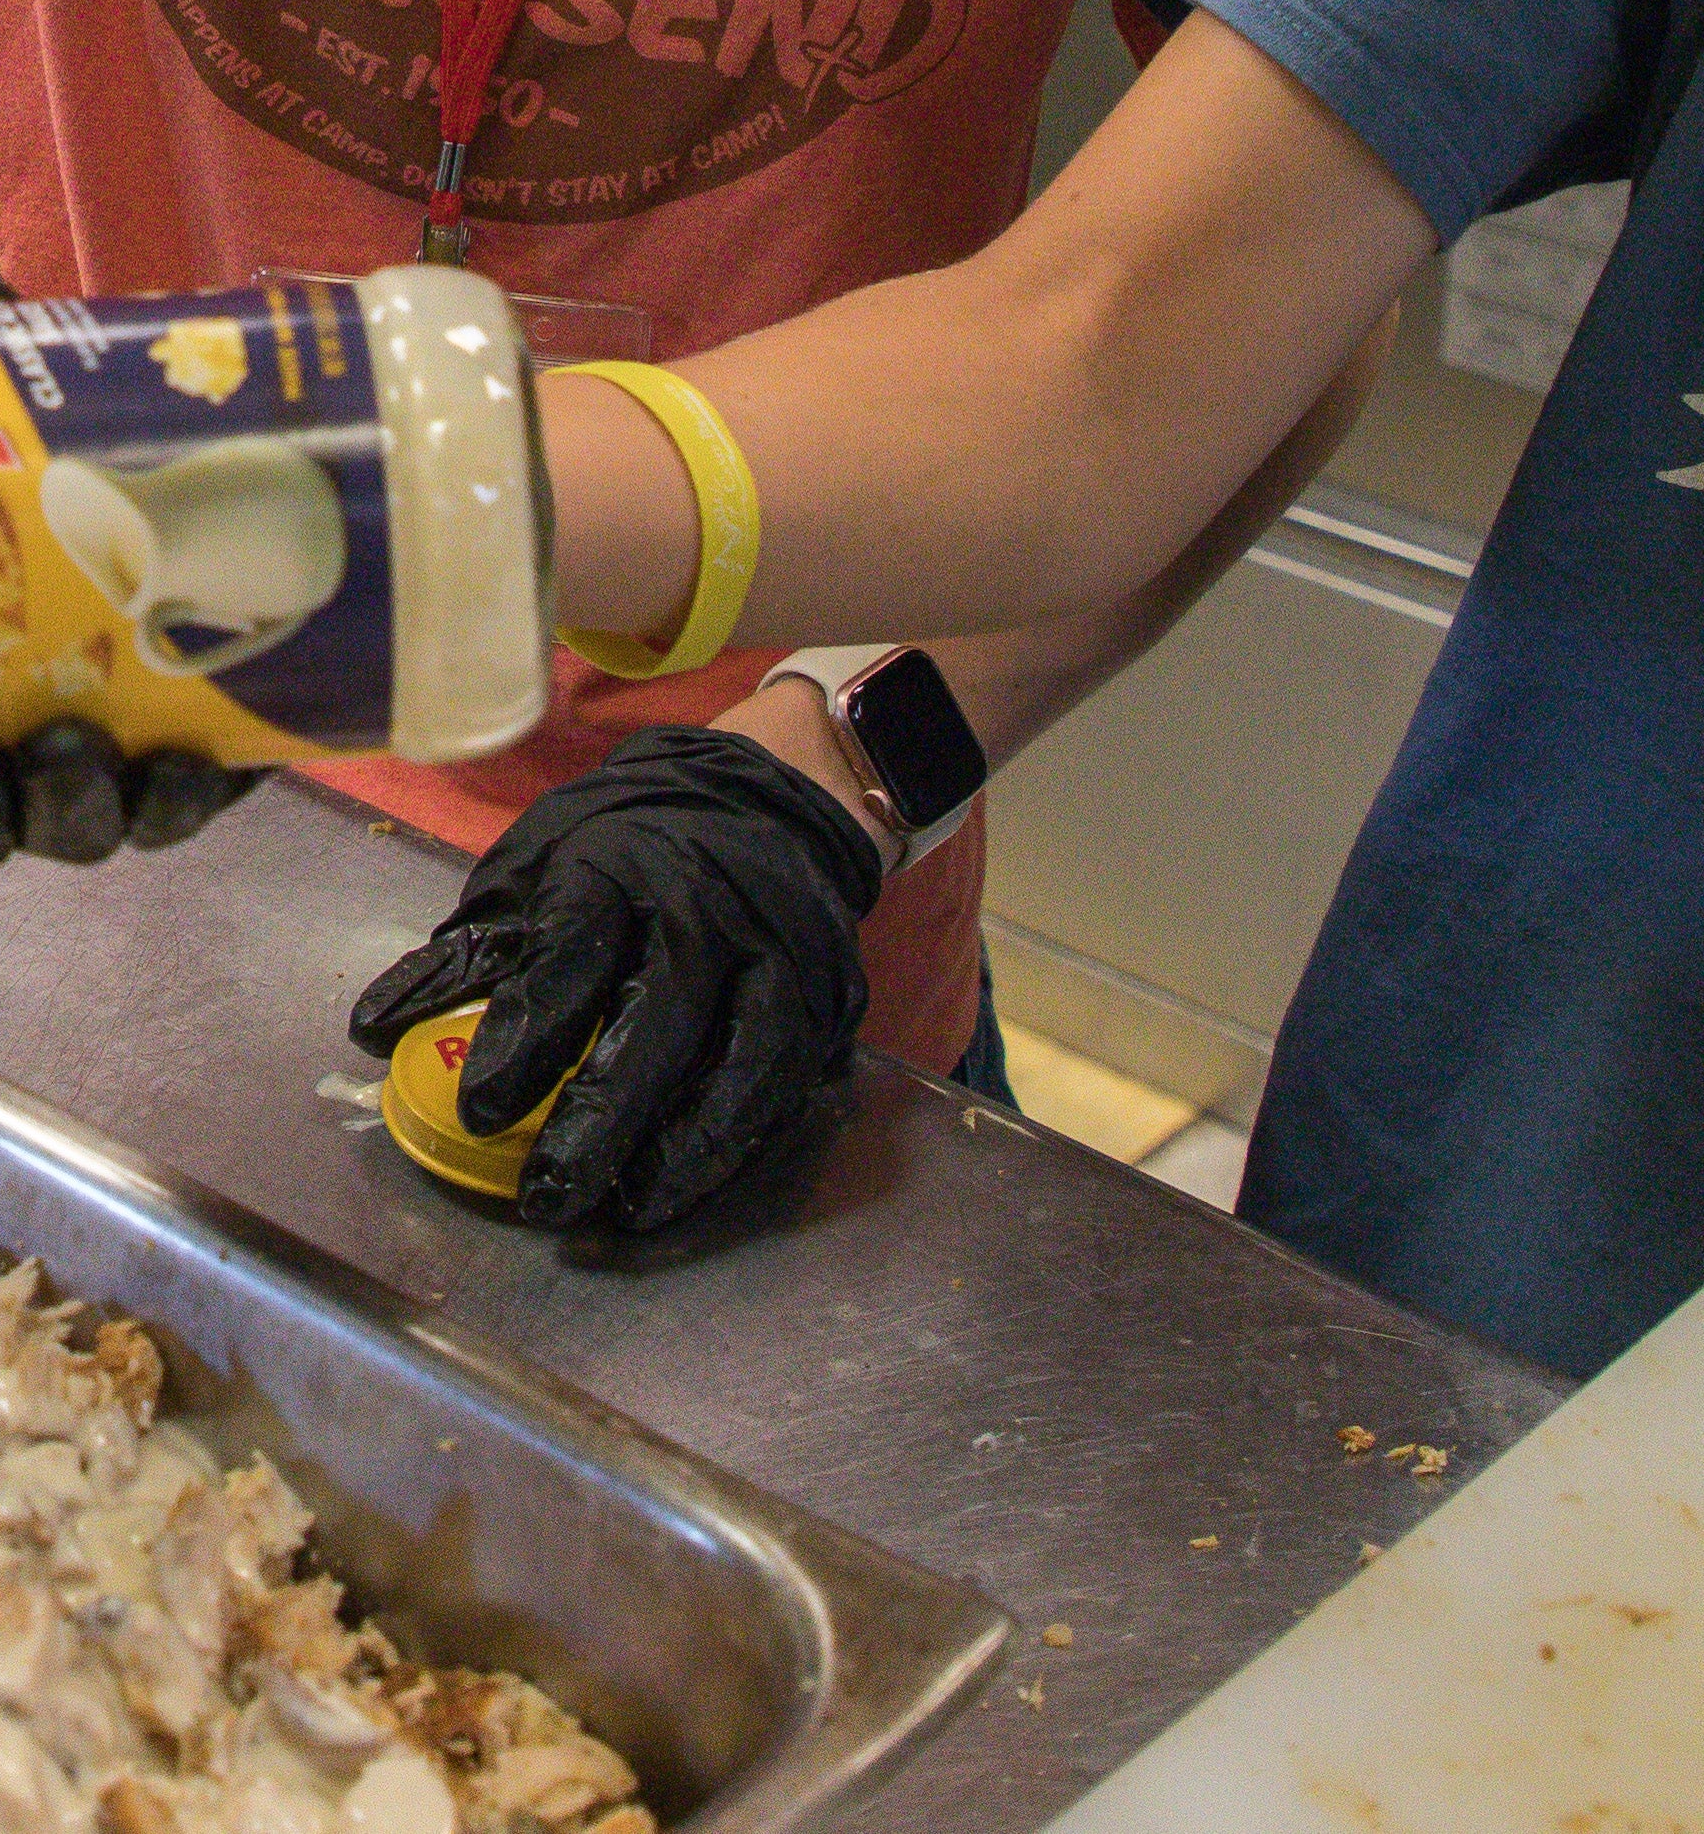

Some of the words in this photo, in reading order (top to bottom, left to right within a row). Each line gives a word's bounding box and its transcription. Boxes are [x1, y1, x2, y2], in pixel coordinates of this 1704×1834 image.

[315, 26, 392, 97] EST.
[255, 80, 306, 116] AT
[545, 173, 627, 208] STAY
[641, 160, 679, 192] AT
